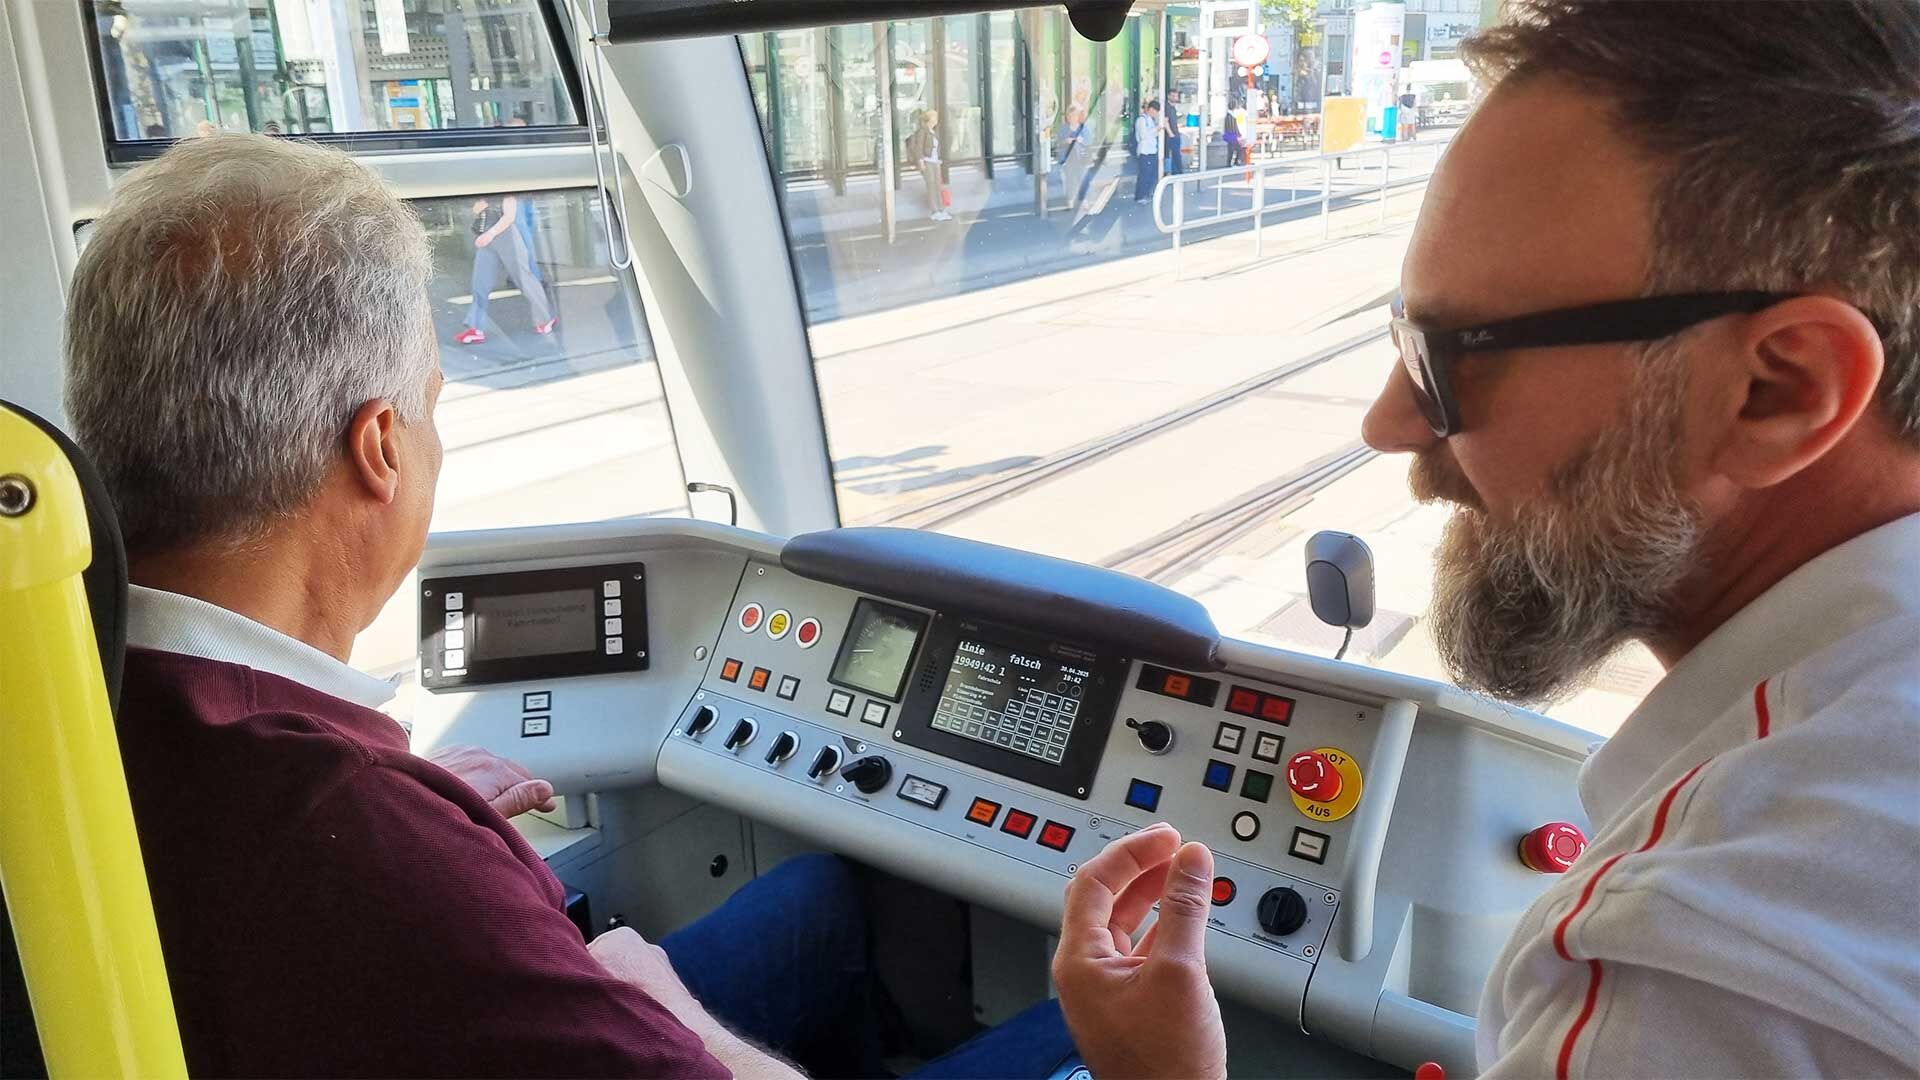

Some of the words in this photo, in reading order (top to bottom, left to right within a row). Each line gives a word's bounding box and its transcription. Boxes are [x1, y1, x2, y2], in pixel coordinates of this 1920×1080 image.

[958, 641, 985, 656] Linie
[1009, 654, 1041, 670] falsch
[999, 667, 1006, 677] 1
[1321, 753, 1346, 766] NOT
[1306, 804, 1331, 818] AUS
